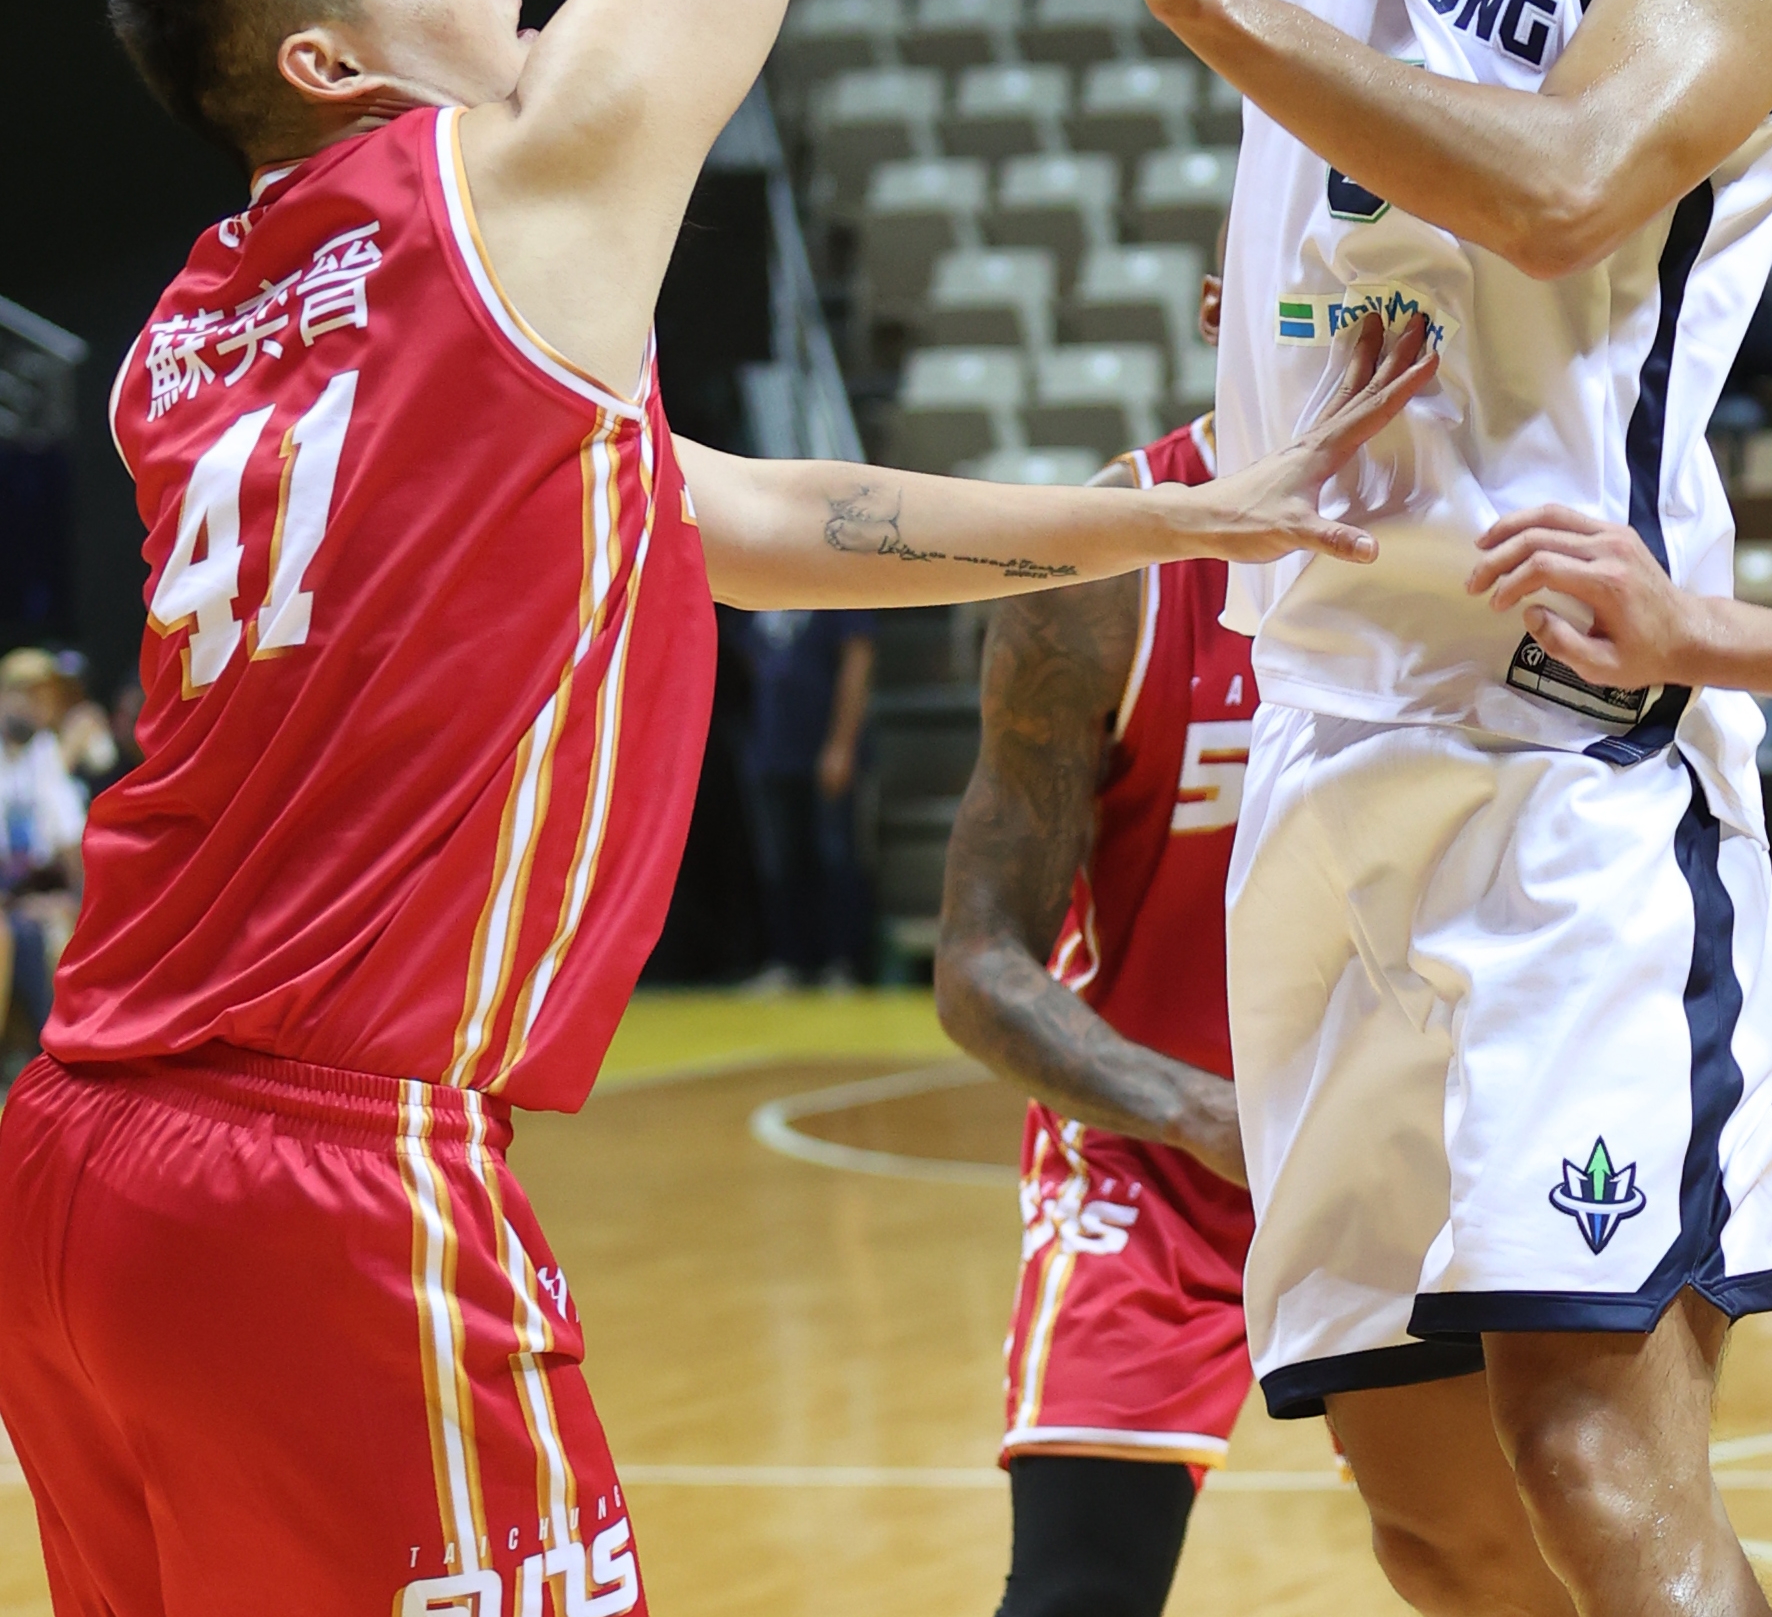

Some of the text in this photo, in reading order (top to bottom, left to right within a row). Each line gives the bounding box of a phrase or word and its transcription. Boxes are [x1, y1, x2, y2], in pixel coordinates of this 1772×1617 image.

[146, 220, 382, 422] 蘇奕晉
[147, 369, 360, 701] 41
[409, 1484, 621, 1569] TAICHUNG
